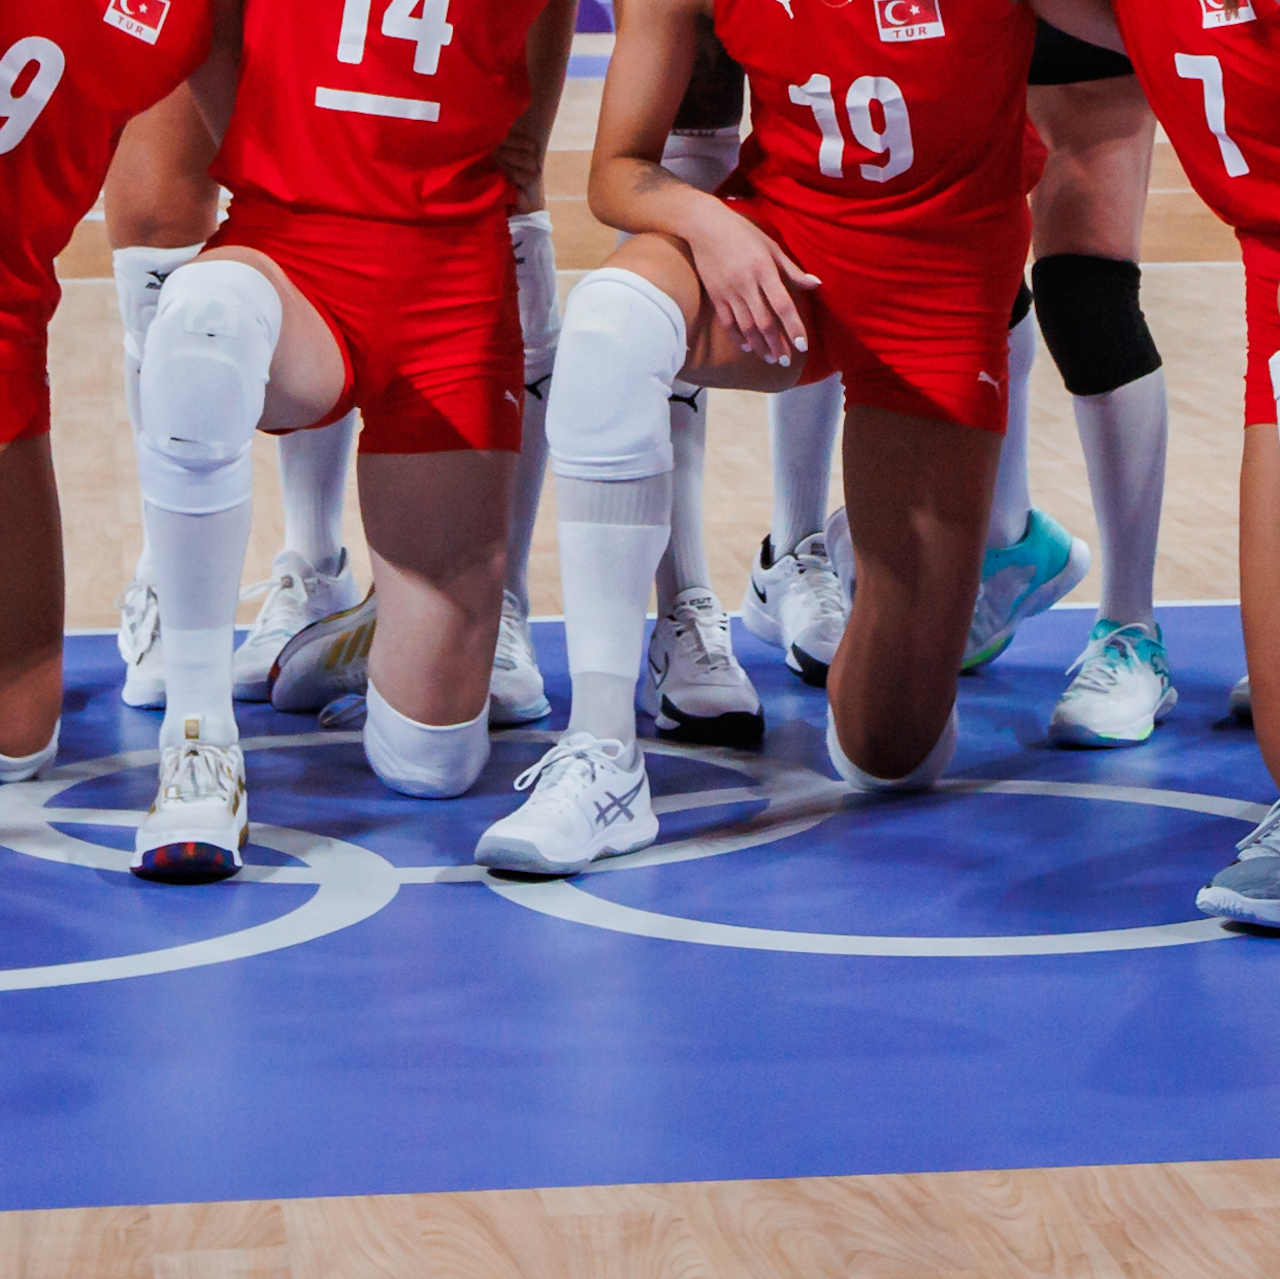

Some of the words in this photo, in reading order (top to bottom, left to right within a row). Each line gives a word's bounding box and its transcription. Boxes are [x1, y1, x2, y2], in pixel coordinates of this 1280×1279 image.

[116, 15, 144, 35] TUR
[893, 26, 928, 38] TUR
[788, 73, 914, 182] 19
[1174, 53, 1249, 177] 7
